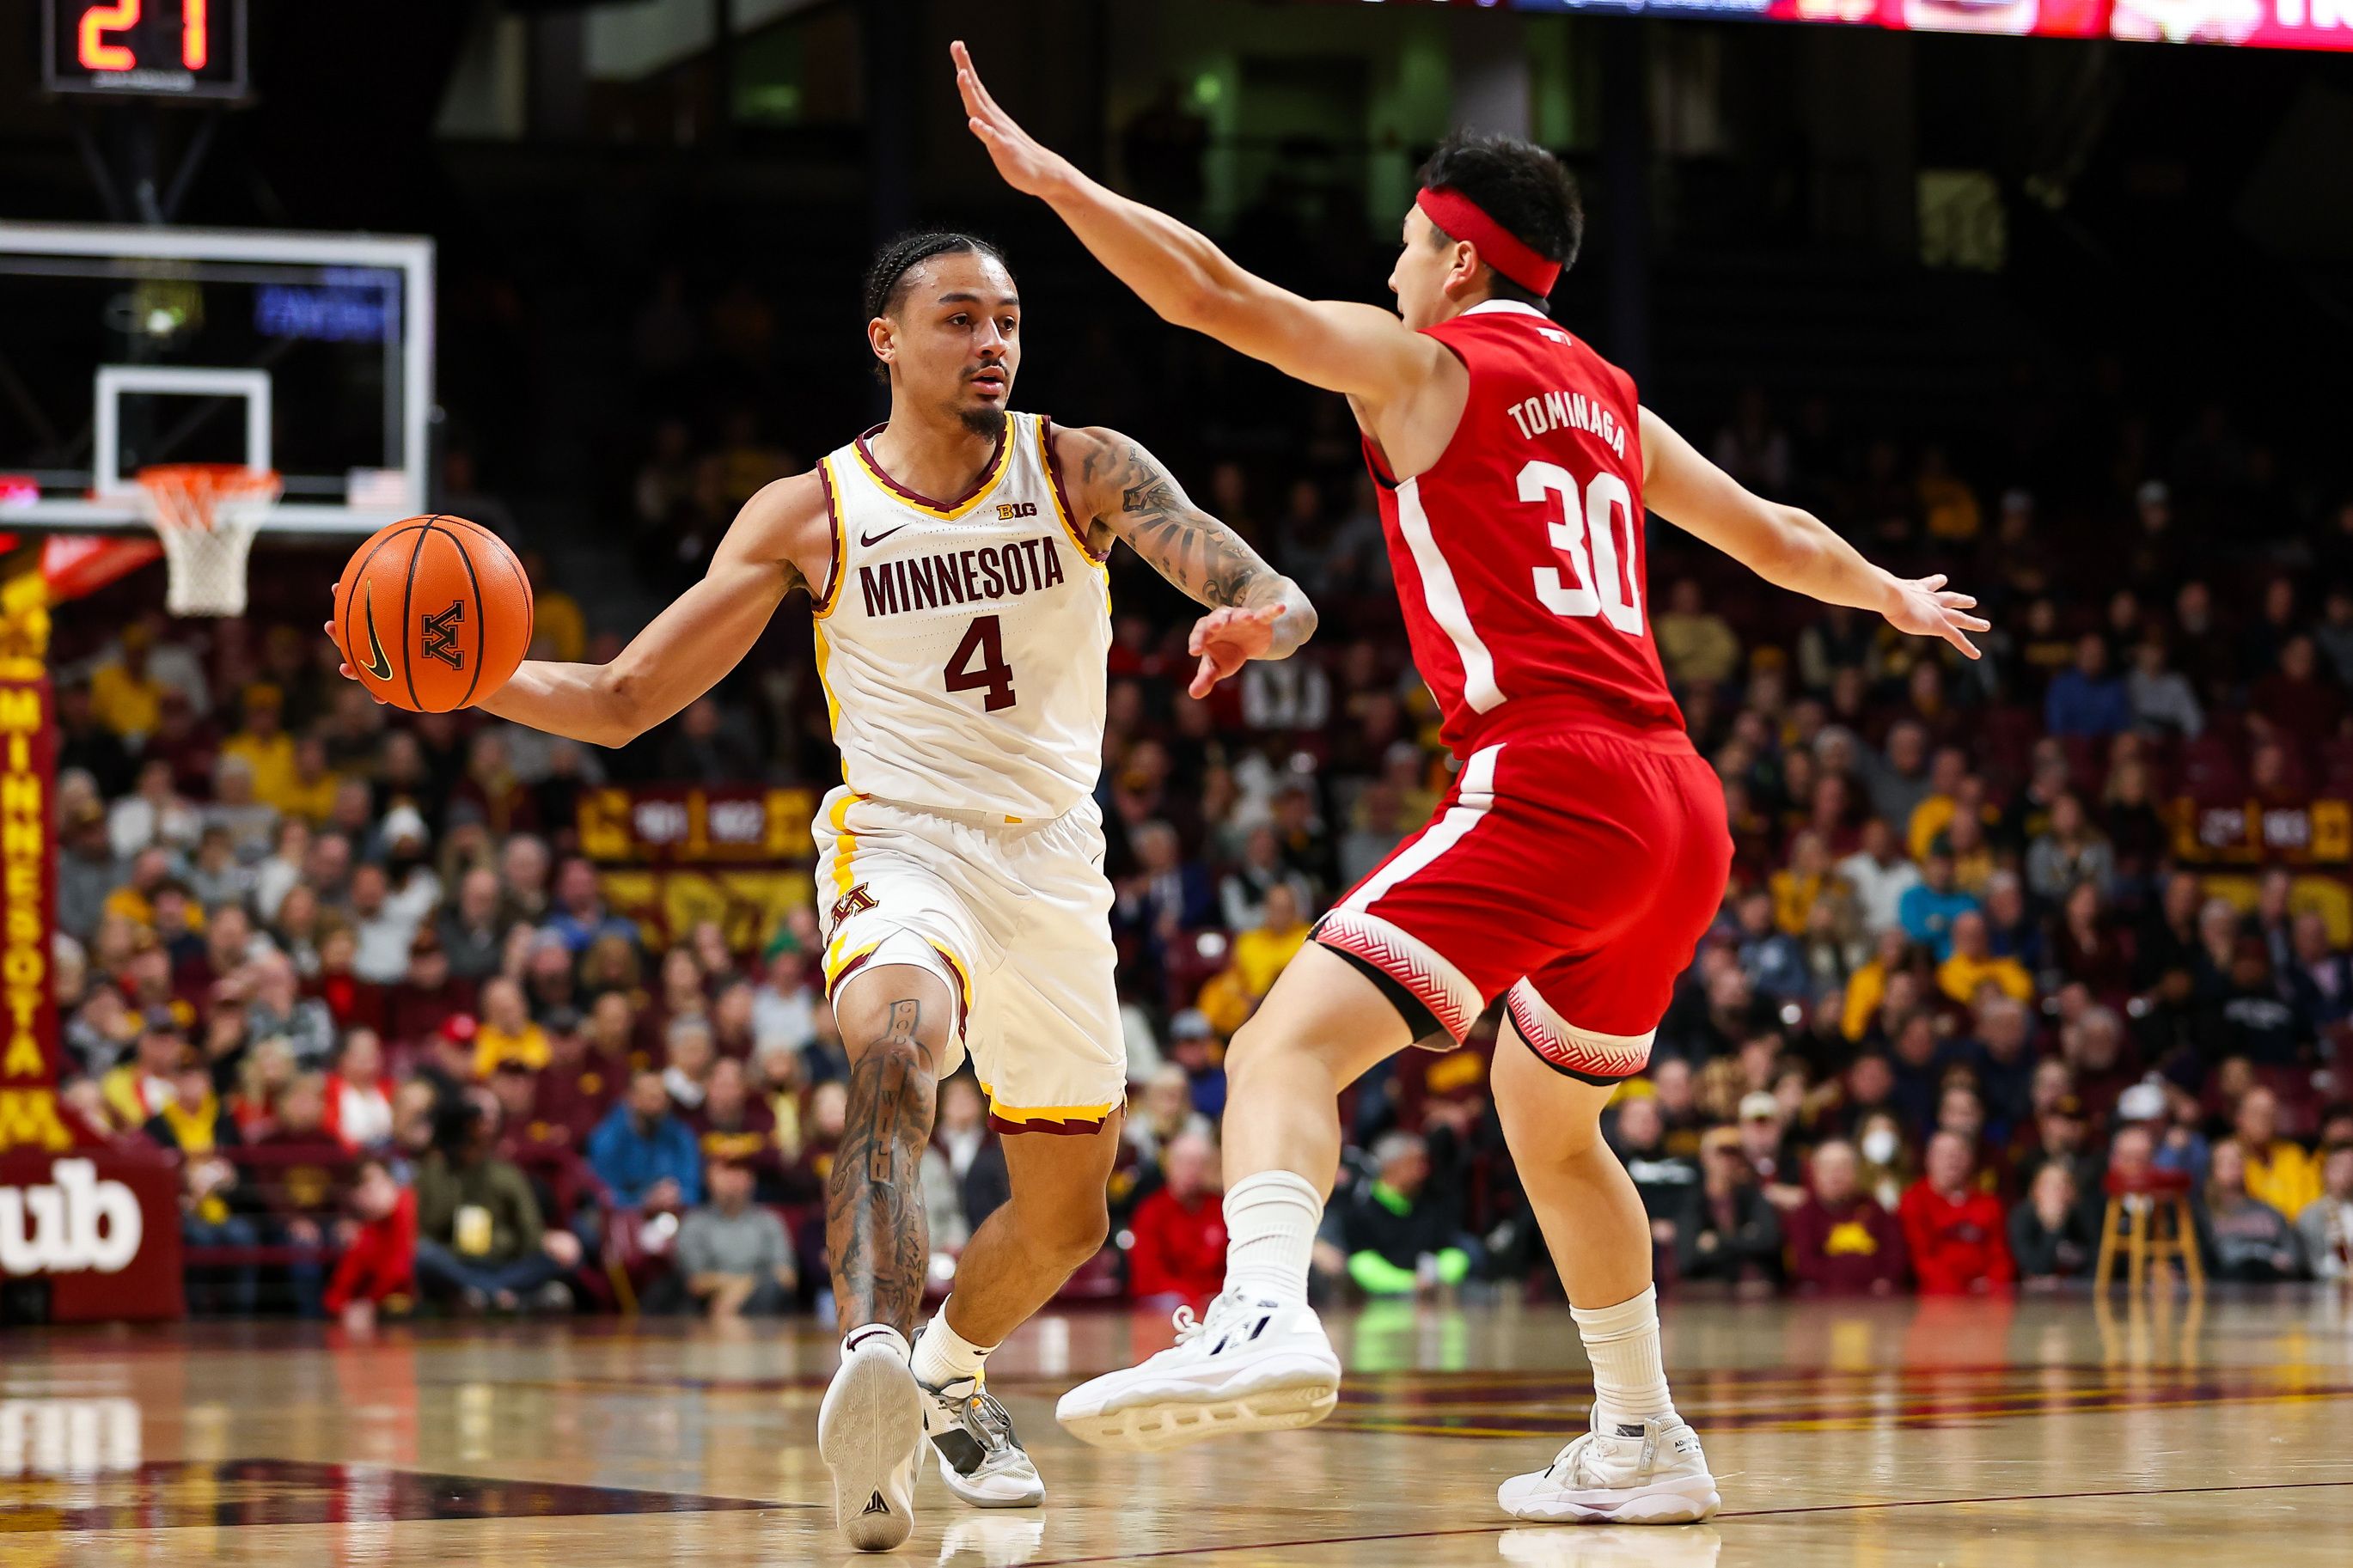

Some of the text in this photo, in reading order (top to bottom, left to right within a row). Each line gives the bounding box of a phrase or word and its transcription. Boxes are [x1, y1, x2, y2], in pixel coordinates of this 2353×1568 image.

[1507, 390, 1625, 460] TOMINAGA
[859, 535, 1065, 617] MINNESOTA
[1515, 460, 1644, 638] 30
[944, 614, 1017, 712] 4
[0, 688, 43, 1077] MINNESOTA
